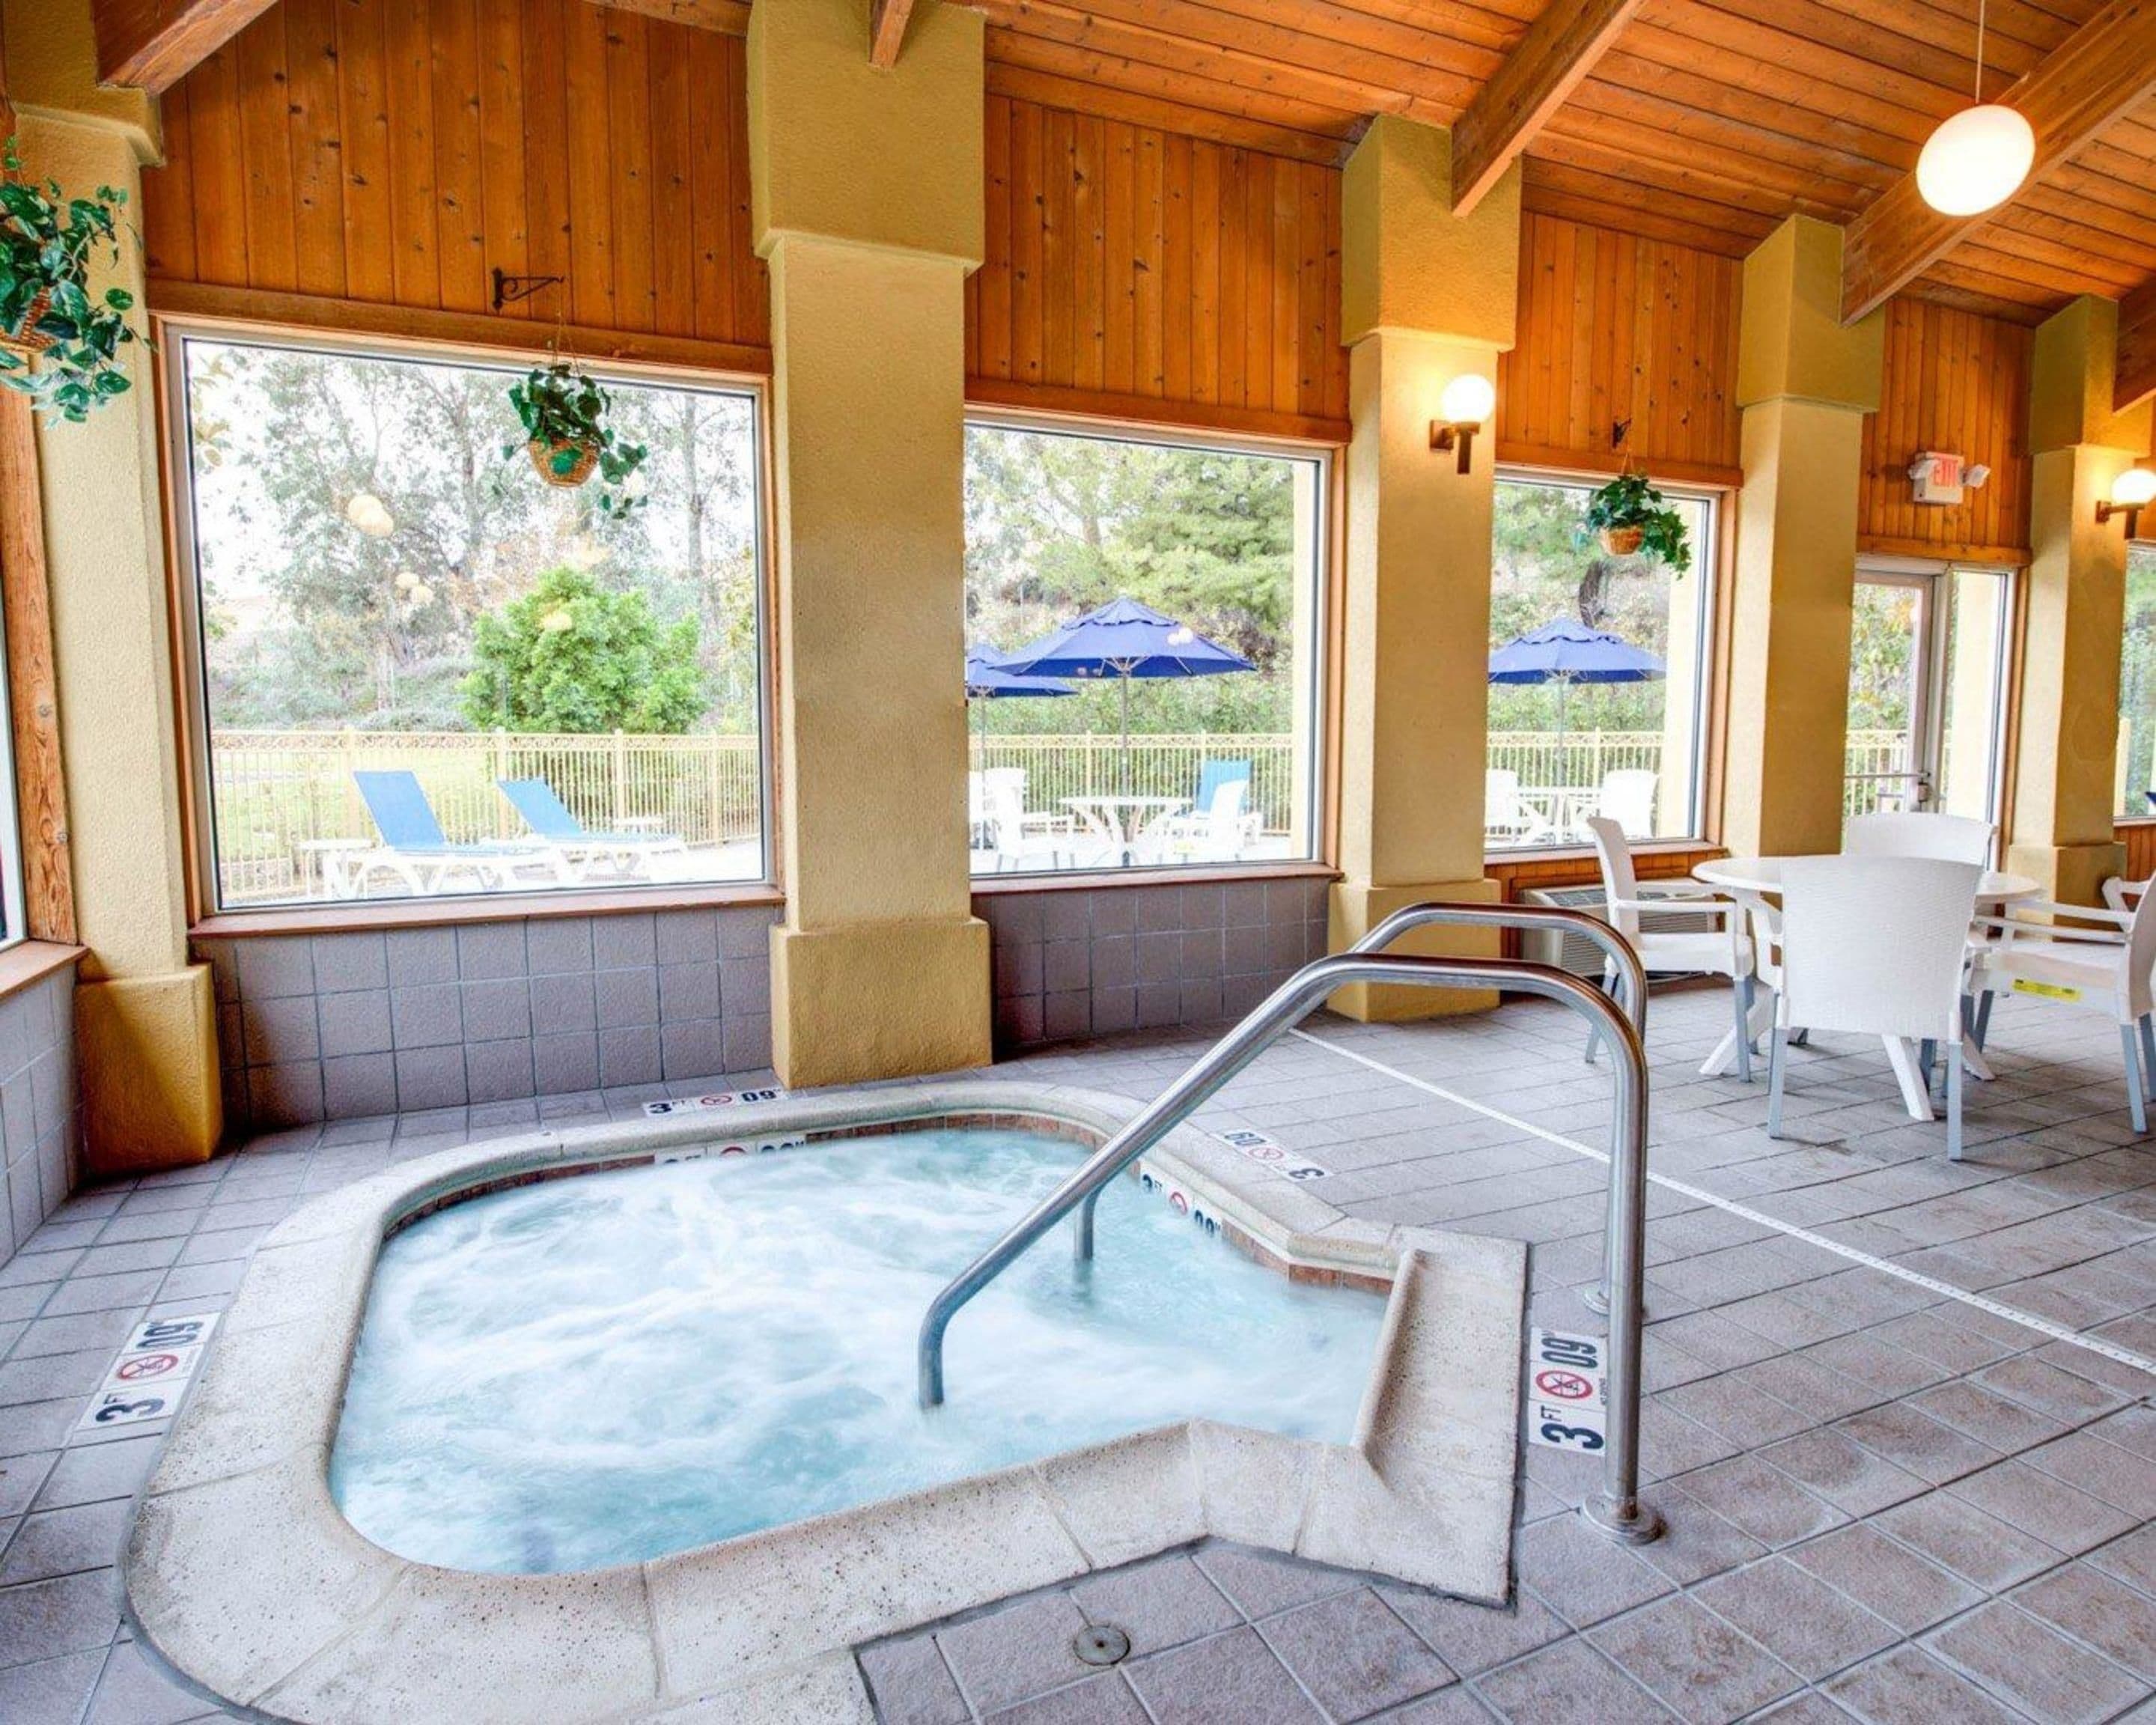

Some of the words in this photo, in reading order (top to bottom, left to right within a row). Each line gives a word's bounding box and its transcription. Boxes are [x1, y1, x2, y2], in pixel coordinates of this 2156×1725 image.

[1934, 458, 1958, 487] EXIT
[649, 1102, 672, 1114] 3
[95, 1398, 165, 1422] 3
[1541, 1405, 1562, 1422] FT
[1541, 1423, 1604, 1449] 3
